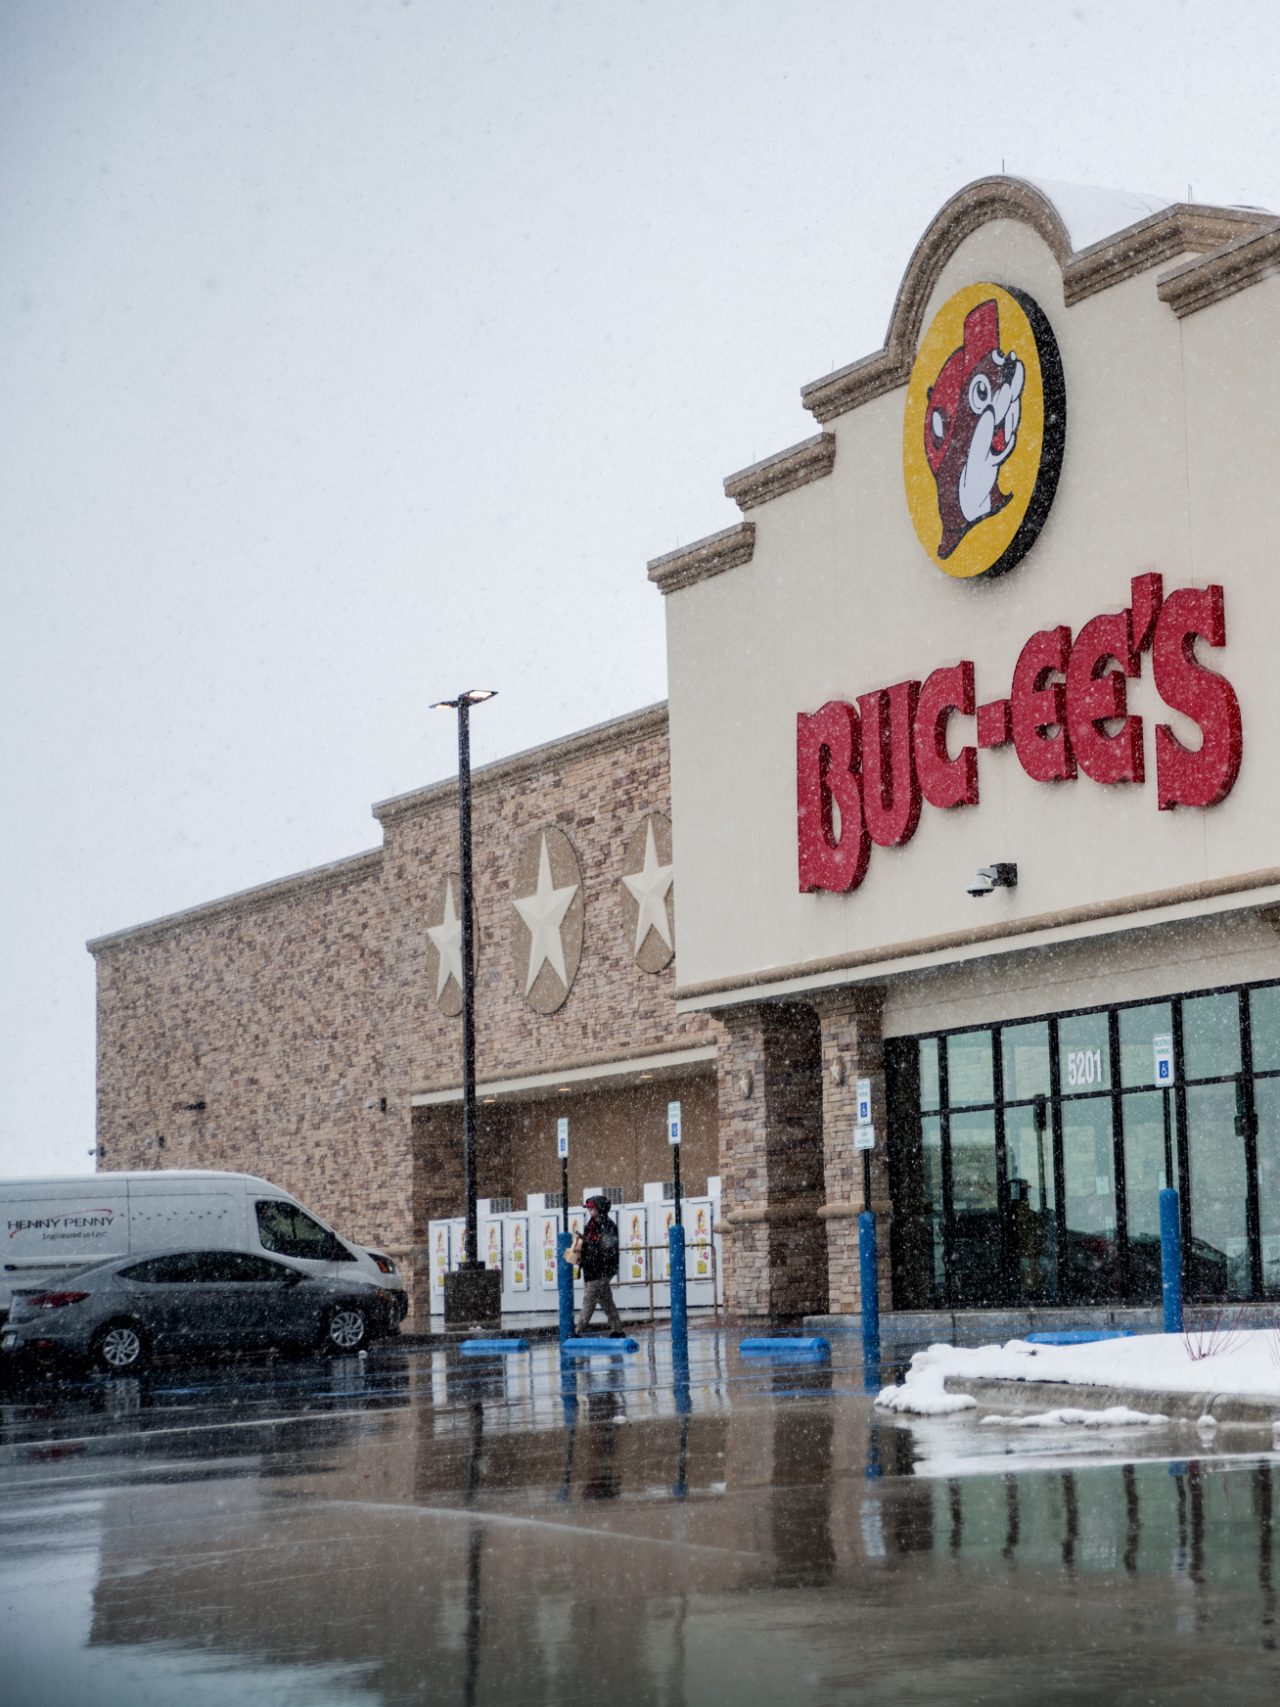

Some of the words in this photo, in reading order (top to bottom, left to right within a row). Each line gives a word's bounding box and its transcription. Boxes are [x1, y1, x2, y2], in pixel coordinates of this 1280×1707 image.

[797, 572, 1243, 893] BUC-EE'S
[1068, 1049, 1102, 1086] 5201
[8, 1218, 60, 1230] HENNY
[64, 1217, 114, 1228] PENNY
